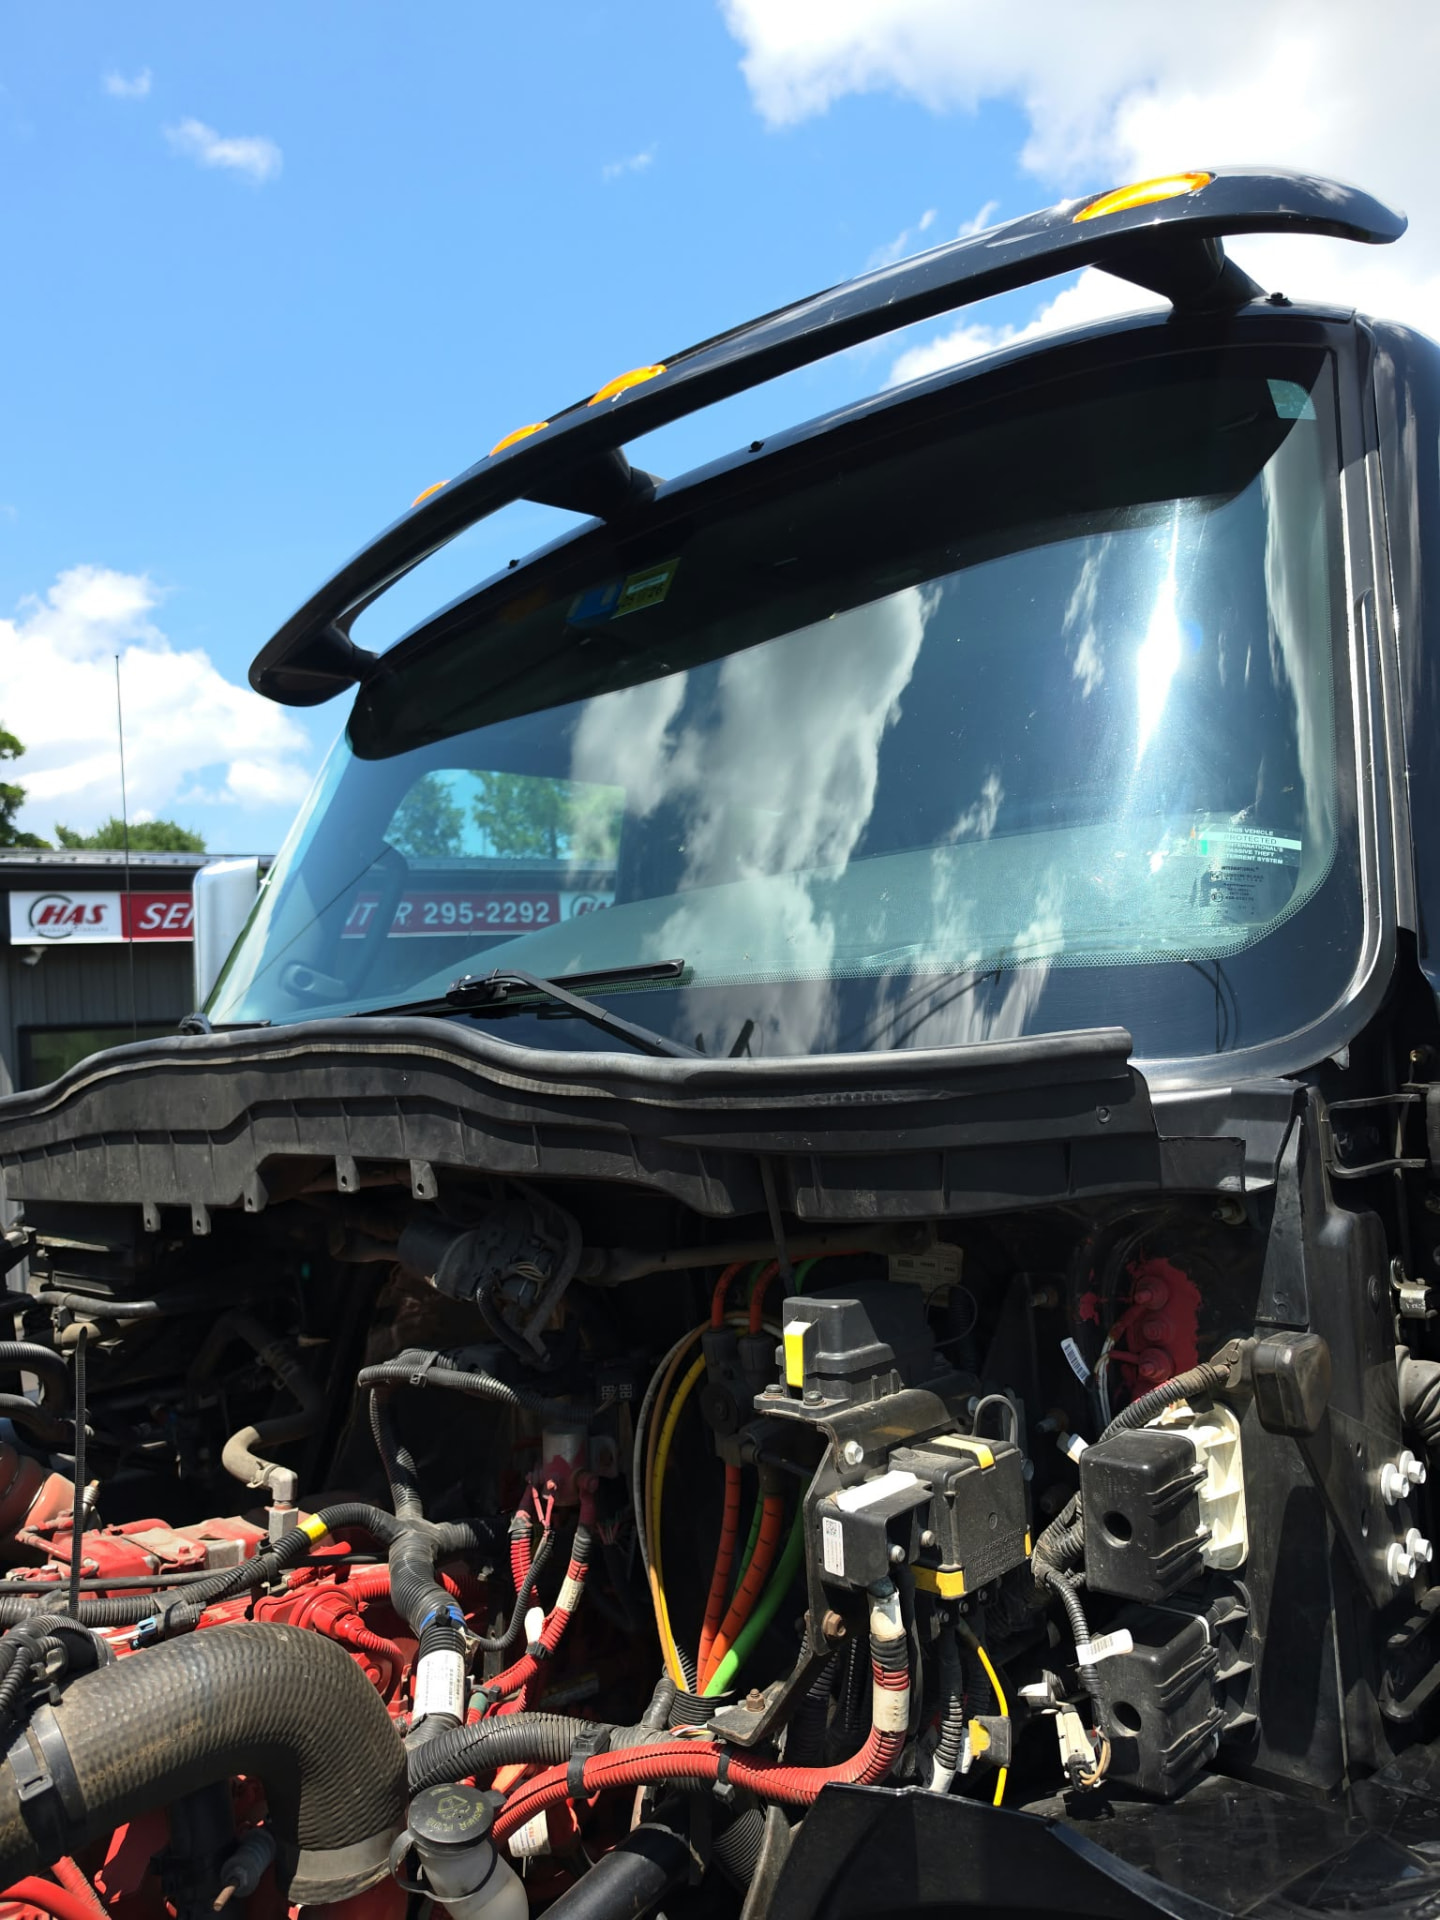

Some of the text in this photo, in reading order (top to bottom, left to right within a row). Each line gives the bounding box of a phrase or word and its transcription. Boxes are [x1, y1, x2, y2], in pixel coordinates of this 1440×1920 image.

[1224, 834, 1277, 845] PROTECTED
[37, 904, 108, 926] HAS
[423, 901, 550, 925] 295-2292
